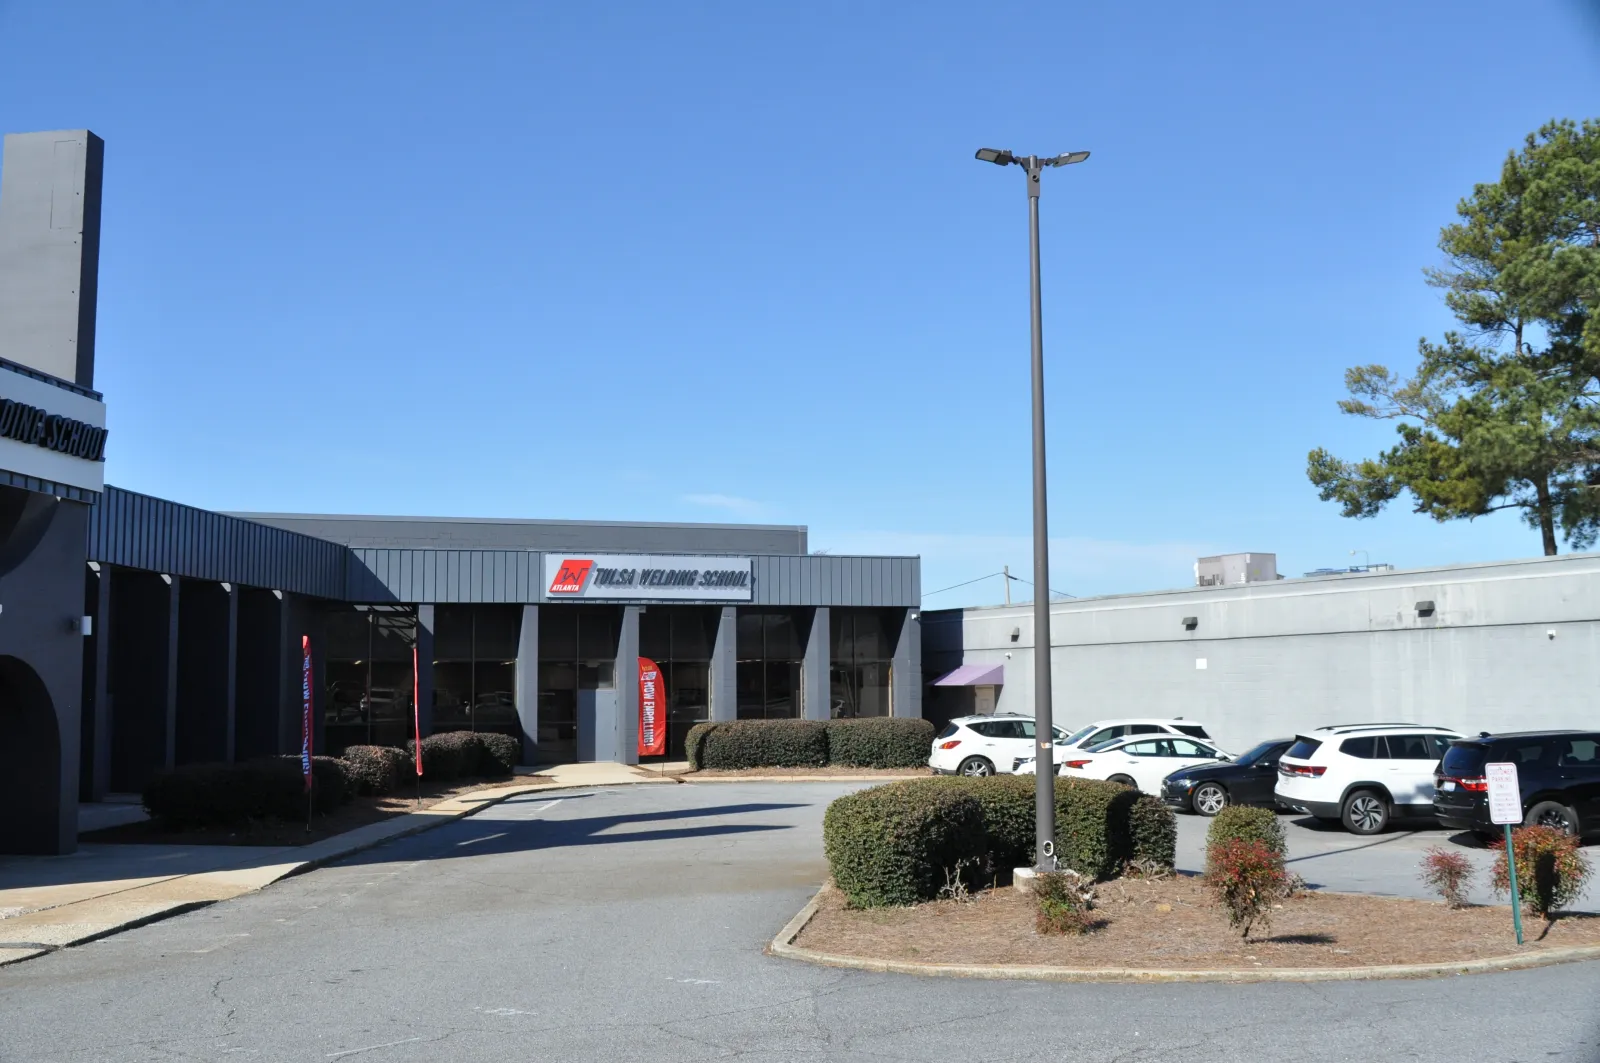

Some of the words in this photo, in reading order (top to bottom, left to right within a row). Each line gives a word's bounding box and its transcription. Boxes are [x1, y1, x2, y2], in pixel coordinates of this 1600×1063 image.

[0, 398, 46, 446] DING
[45, 414, 109, 462] SCHOOL
[551, 584, 580, 592] ATLANTA
[593, 567, 636, 587] TULSA
[638, 568, 699, 588] WELDING
[698, 569, 751, 589] SCHOOL
[643, 681, 655, 699] NOW
[643, 701, 655, 747] ENROLLING!
